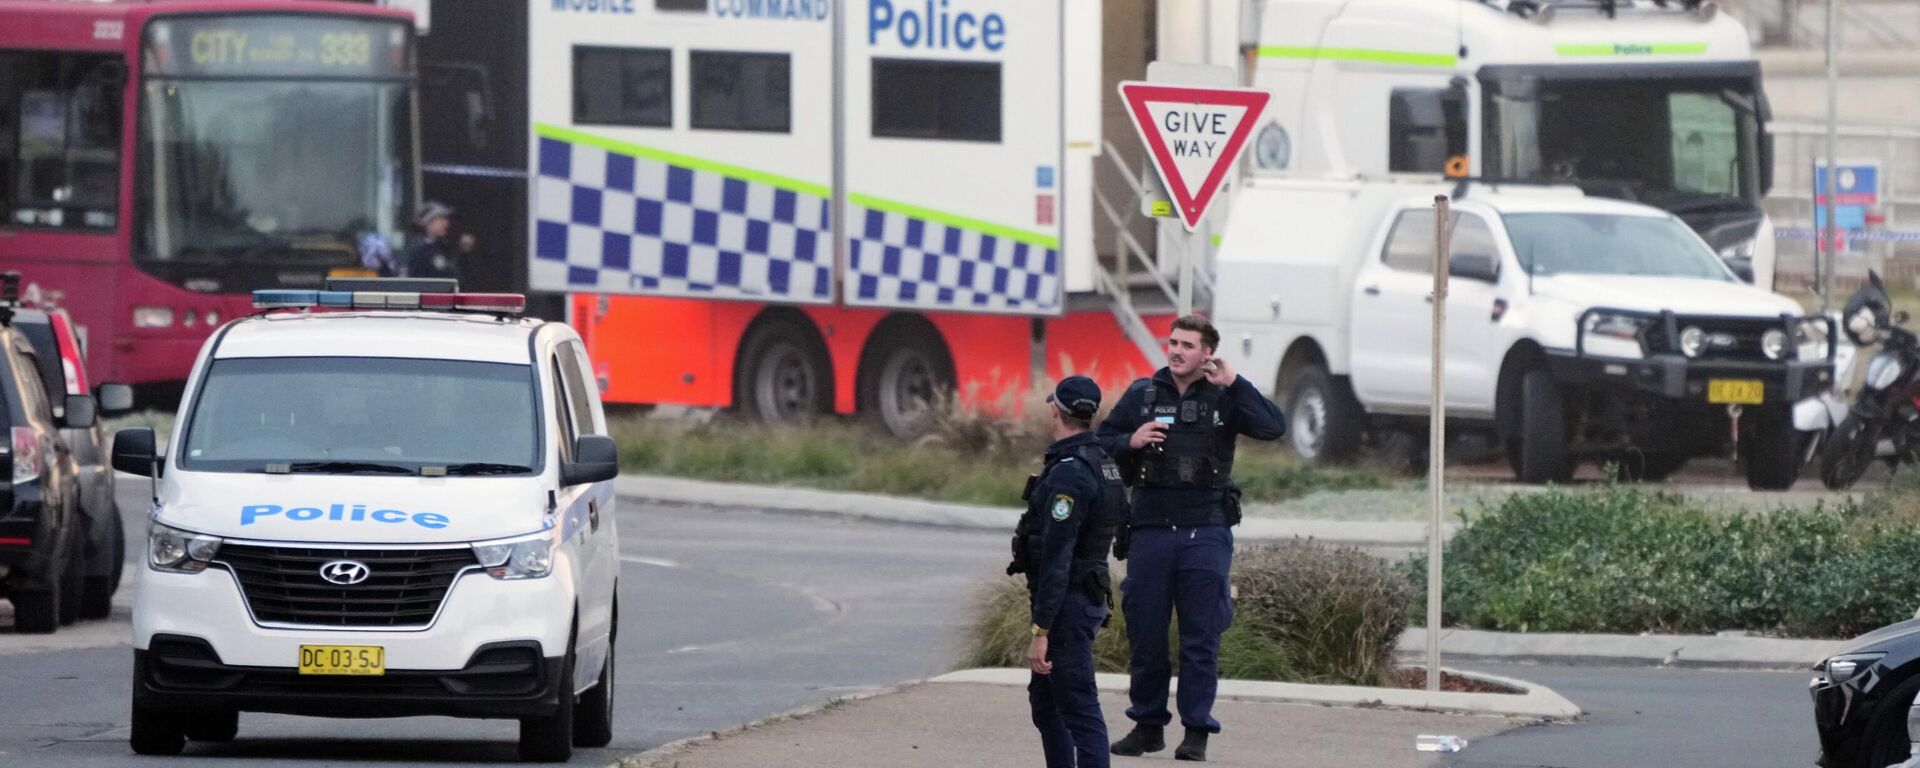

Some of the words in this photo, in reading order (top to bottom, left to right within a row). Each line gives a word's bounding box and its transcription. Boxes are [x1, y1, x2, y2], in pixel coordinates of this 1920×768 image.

[714, 0, 829, 20] COMMAND
[868, 0, 1005, 51] Police
[191, 30, 247, 64] CITY
[321, 32, 370, 65] 333
[1165, 111, 1227, 134] GIVE
[1173, 140, 1216, 158] WAY
[1154, 406, 1177, 414] POLICE
[241, 504, 449, 529] Police
